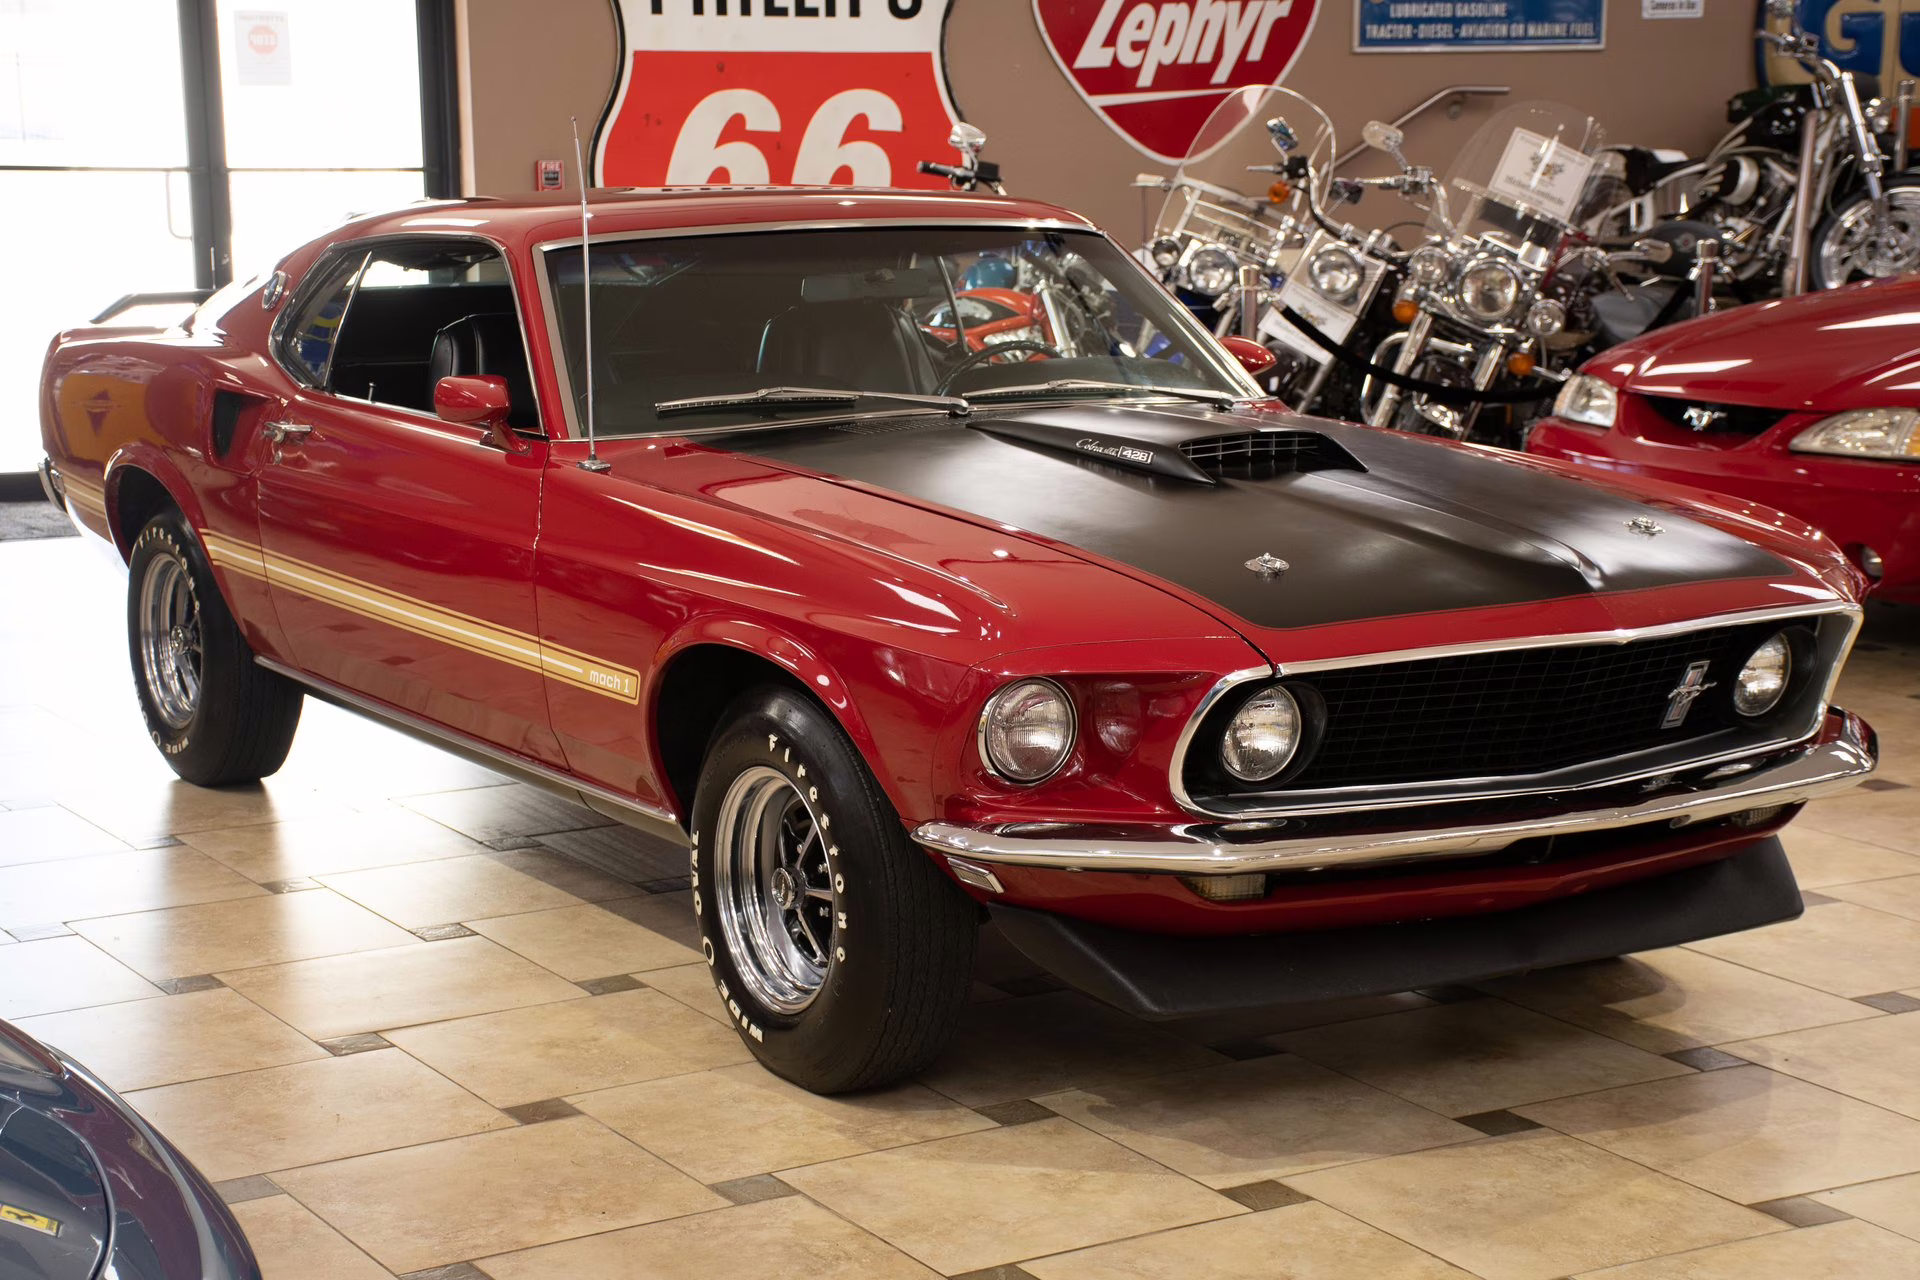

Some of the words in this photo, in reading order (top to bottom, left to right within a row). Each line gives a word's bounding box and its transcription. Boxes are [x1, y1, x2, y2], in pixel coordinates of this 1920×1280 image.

[1389, 3, 1453, 18] LUBRICATED
[1454, 3, 1507, 17] GASOLINE
[1509, 23, 1525, 37] OR
[1527, 23, 1568, 37] MARINE
[1568, 22, 1595, 36] FUEL
[1073, 0, 1291, 87] Zephyr
[665, 88, 903, 186] 66
[1076, 438, 1102, 453] Cobra
[1122, 449, 1148, 461] 428
[139, 527, 200, 611] Firestone
[590, 670, 620, 690] mach
[623, 678, 630, 694] 1
[768, 733, 847, 963] Firestone
[719, 978, 763, 1043] WIDE
